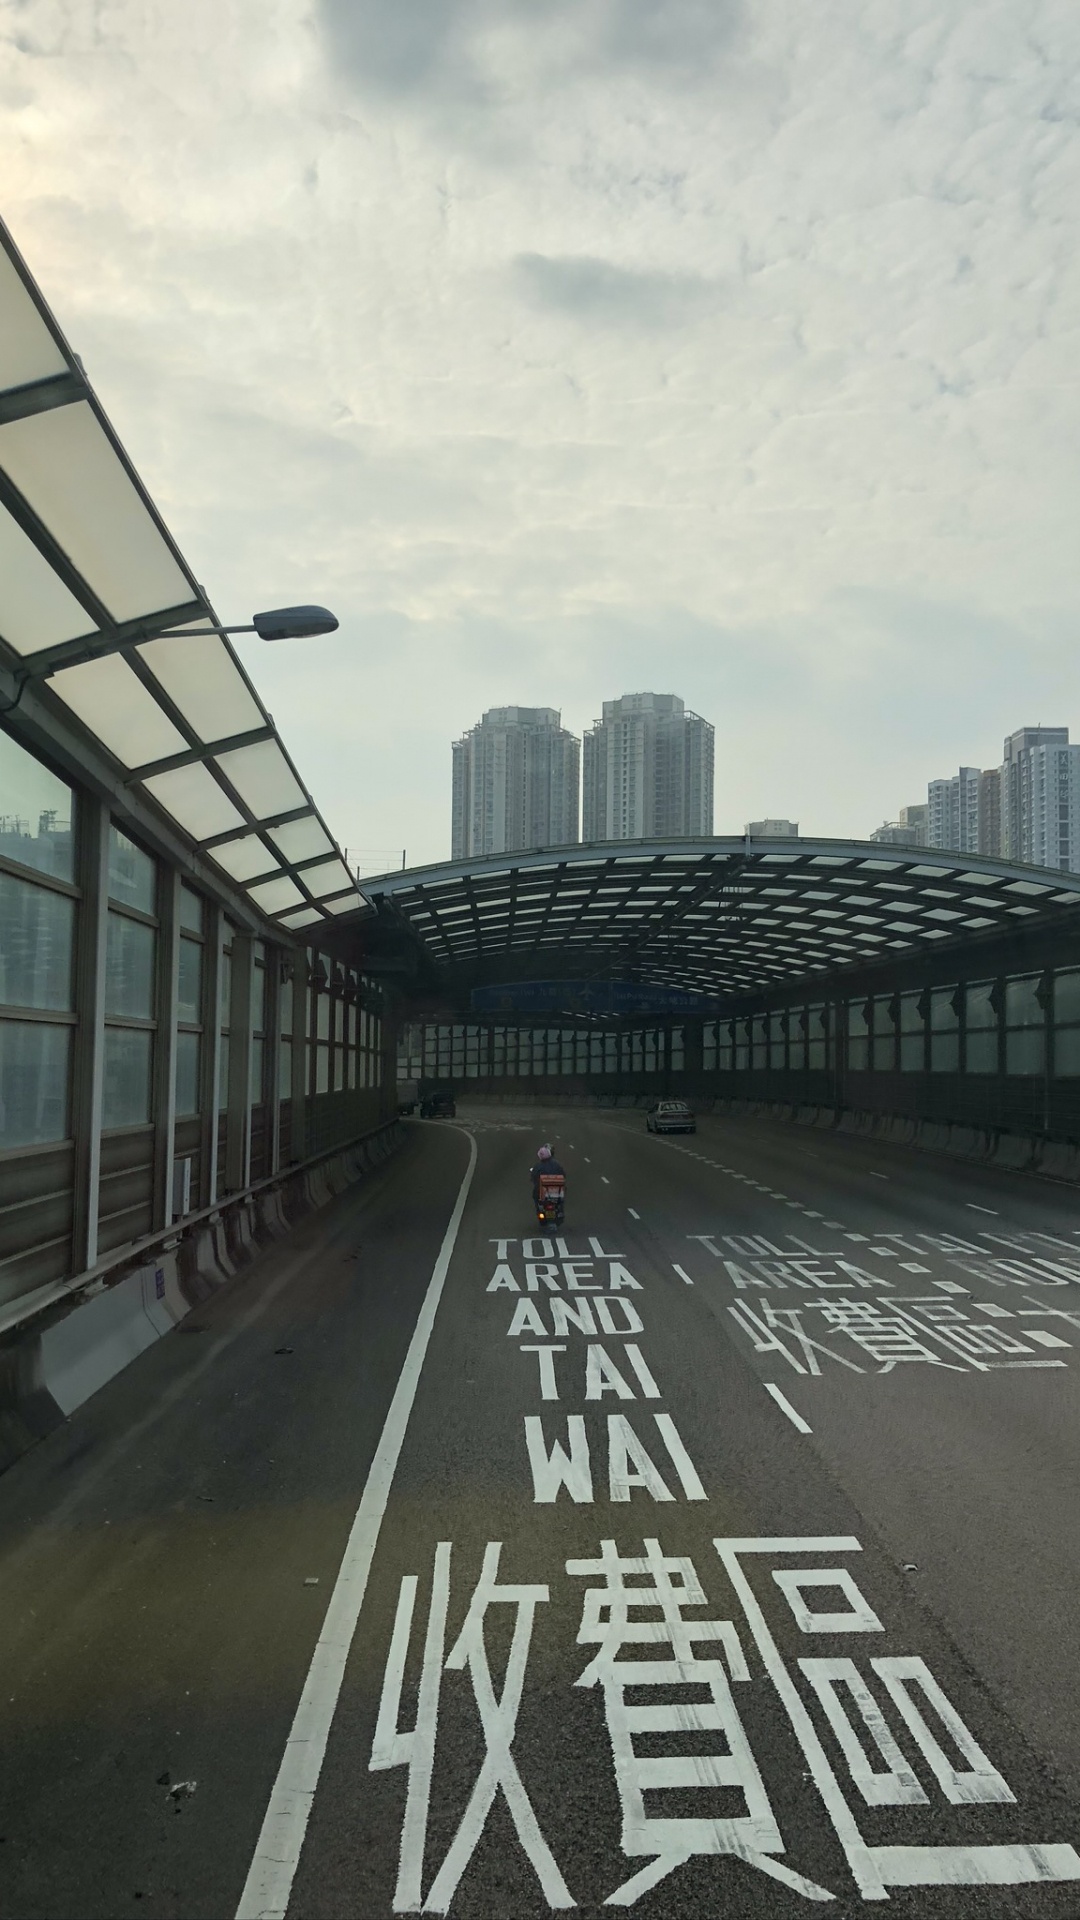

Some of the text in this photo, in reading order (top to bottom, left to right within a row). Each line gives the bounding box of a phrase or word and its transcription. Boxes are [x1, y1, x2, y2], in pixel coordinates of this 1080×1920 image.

[488, 1236, 627, 1260] TOLL
[686, 1234, 845, 1257] TOLL
[873, 1233, 993, 1255] TAI
[485, 1262, 644, 1292] AREA
[722, 1259, 897, 1289] AREA
[506, 1295, 645, 1336] AND
[726, 1297, 1069, 1376] 收費區
[519, 1343, 662, 1400] TAI
[523, 1413, 710, 1503] WAI
[367, 1537, 1080, 1916] 收費區
